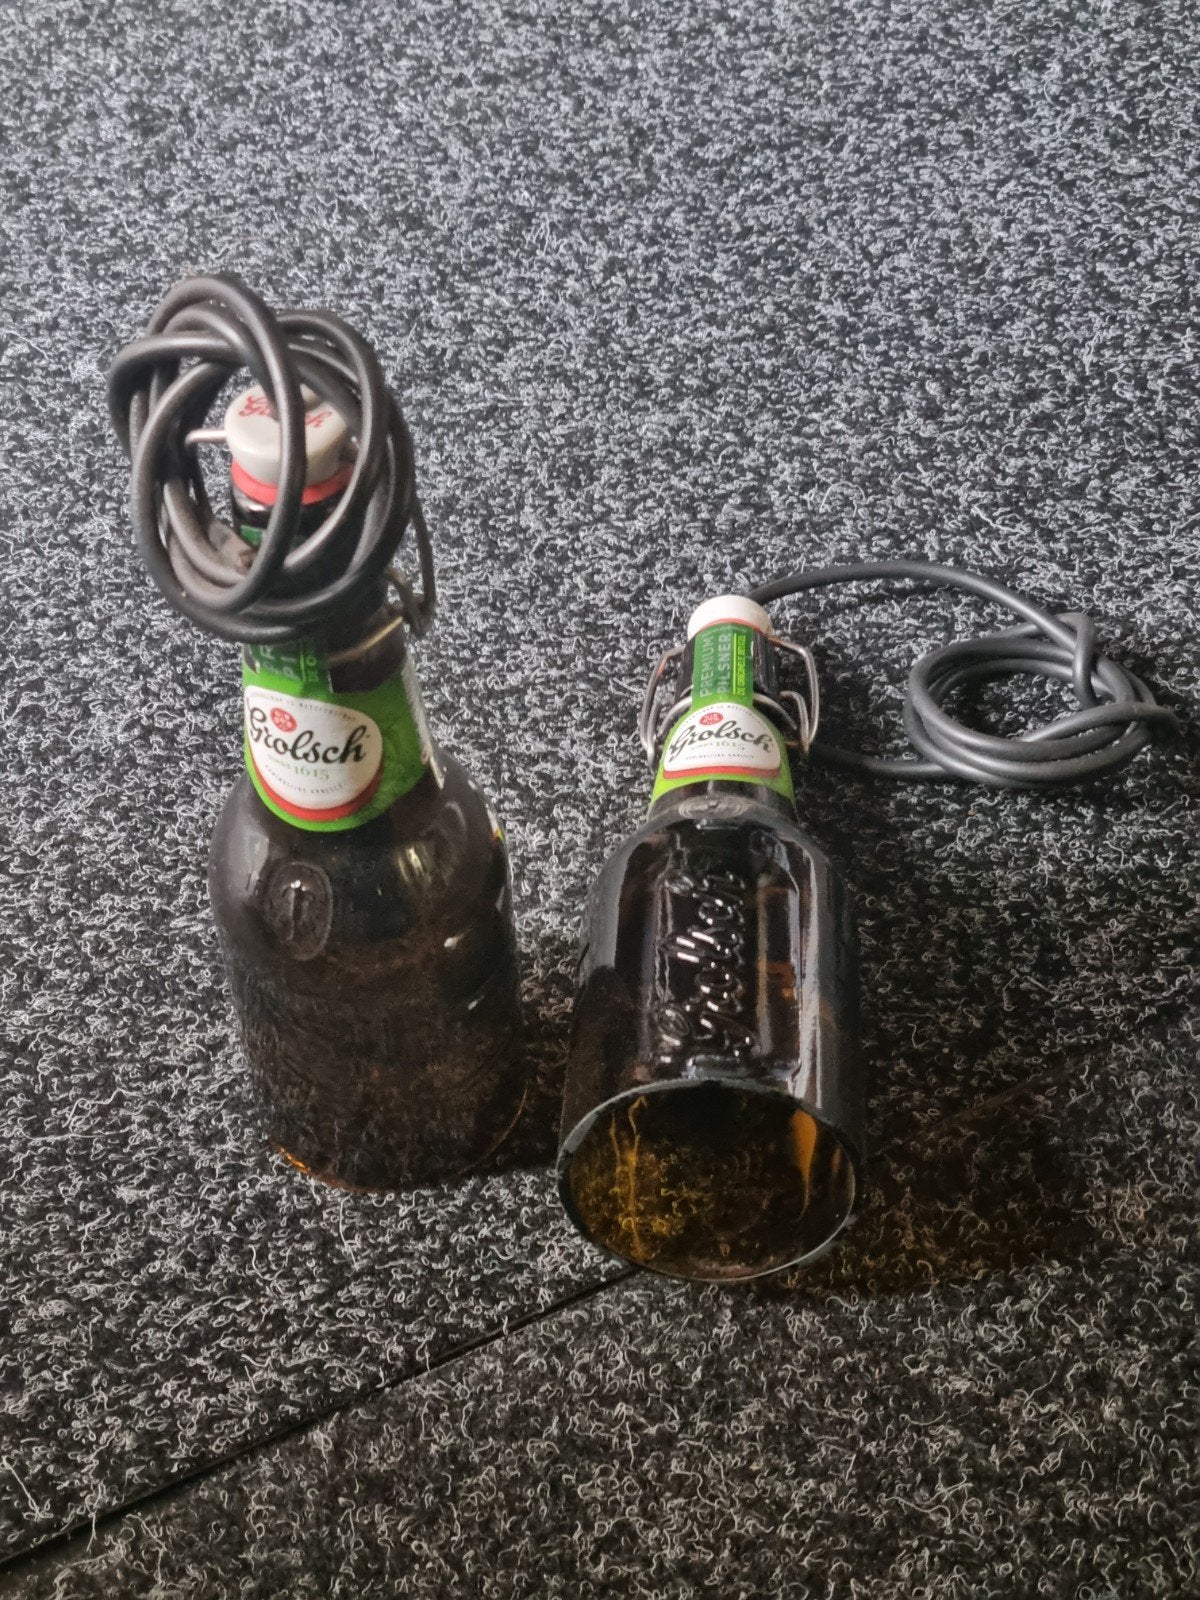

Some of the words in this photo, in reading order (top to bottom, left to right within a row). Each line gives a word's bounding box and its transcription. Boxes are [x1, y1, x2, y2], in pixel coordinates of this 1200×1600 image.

[700, 635, 714, 698] PREMIUM
[717, 632, 732, 694] PILSNER
[247, 701, 367, 765] Grolsch
[668, 720, 773, 763] Grolsch
[294, 766, 331, 782] 1615
